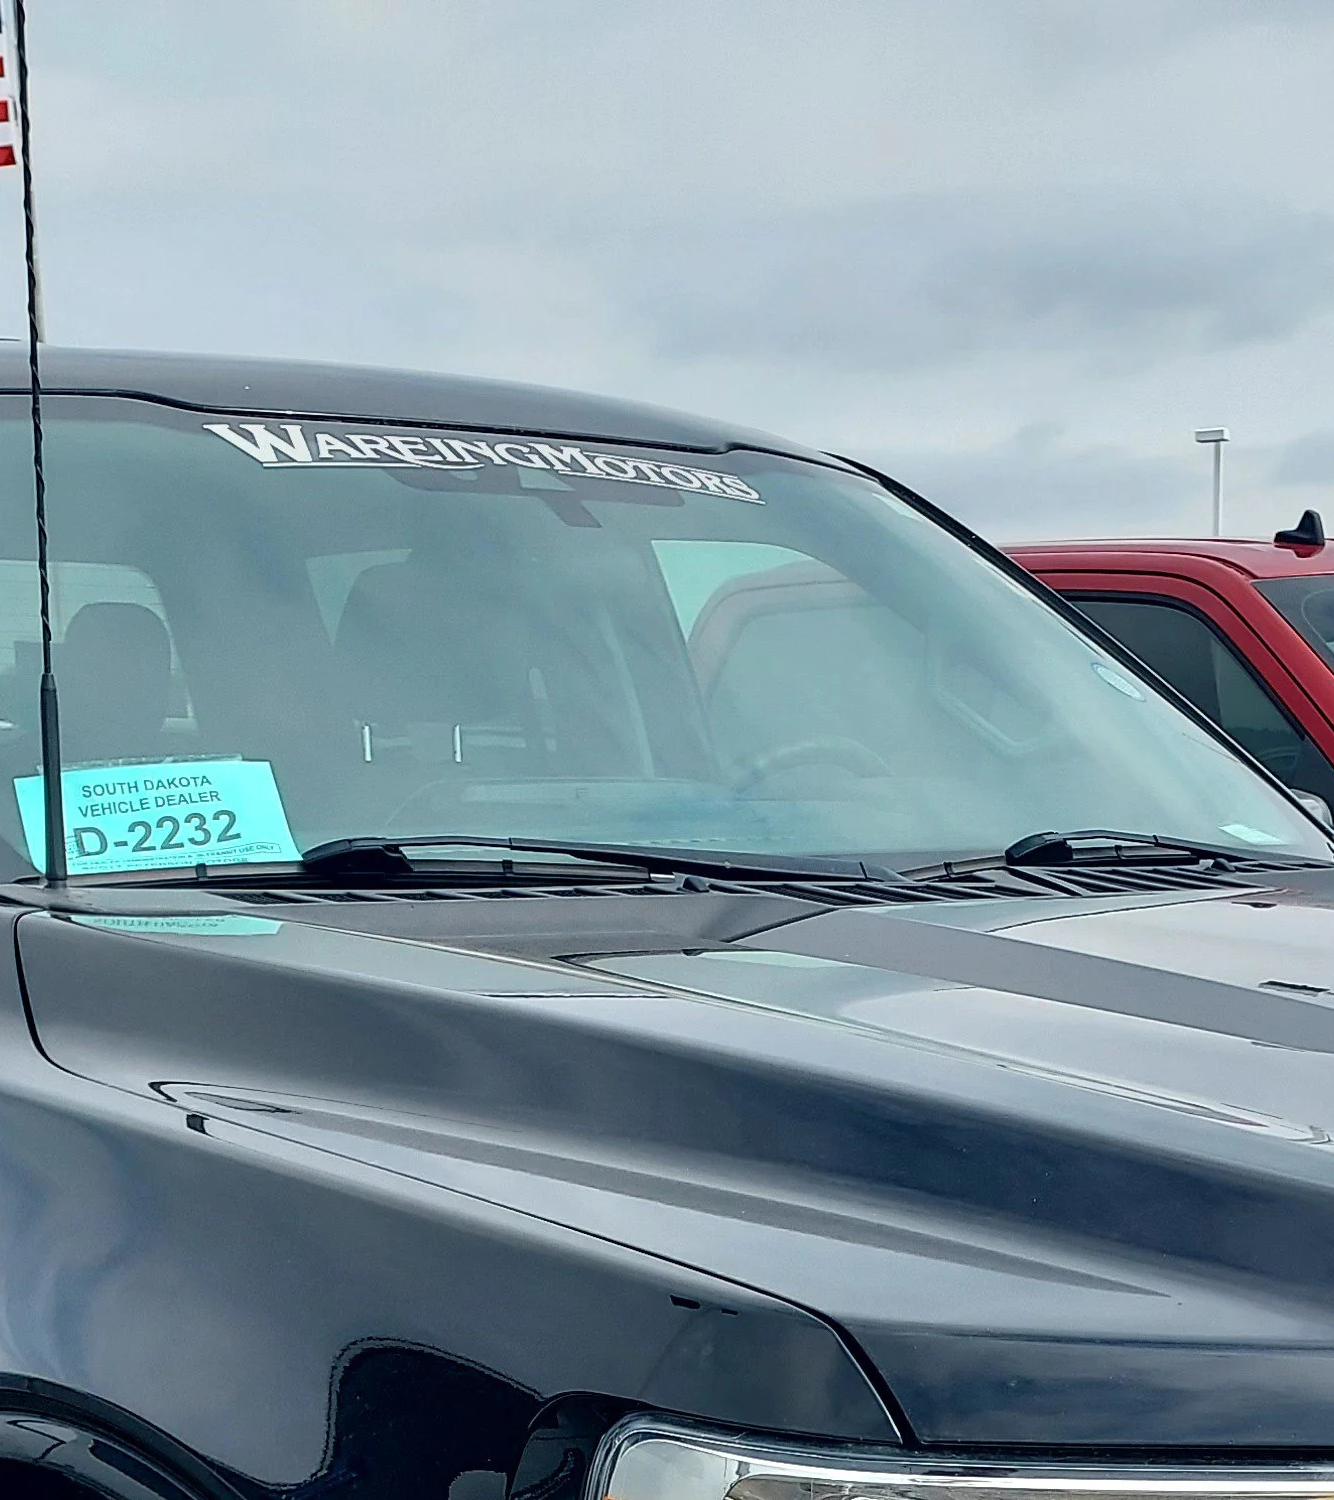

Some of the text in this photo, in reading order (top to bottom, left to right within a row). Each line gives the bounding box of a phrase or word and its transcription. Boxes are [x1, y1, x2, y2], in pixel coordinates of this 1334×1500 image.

[81, 775, 212, 799] SOUTH DAKOTA
[78, 790, 222, 818] VEHICLE DEALER
[73, 809, 242, 858] D-2232
